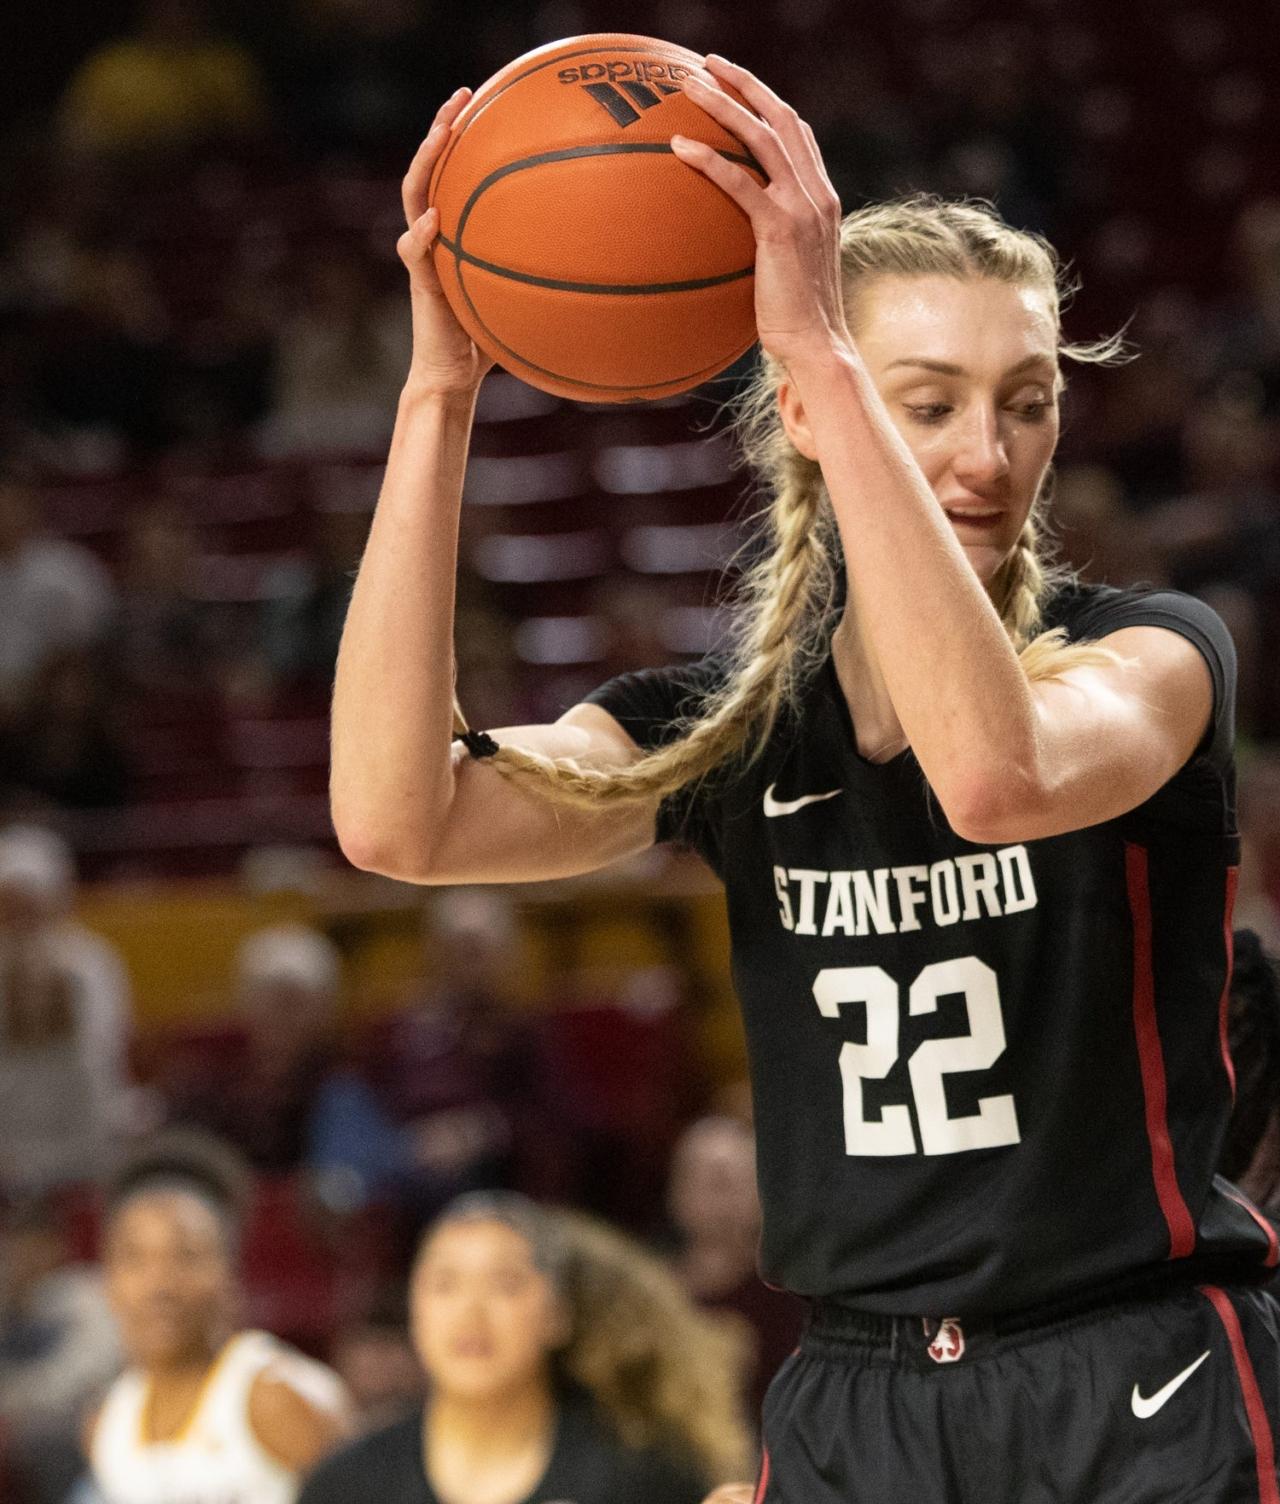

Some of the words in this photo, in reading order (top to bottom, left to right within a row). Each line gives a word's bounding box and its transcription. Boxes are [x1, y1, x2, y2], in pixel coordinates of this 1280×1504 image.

[557, 61, 690, 85] adidas
[773, 844, 1038, 937] STANFORD
[811, 955, 1021, 1156] 22
